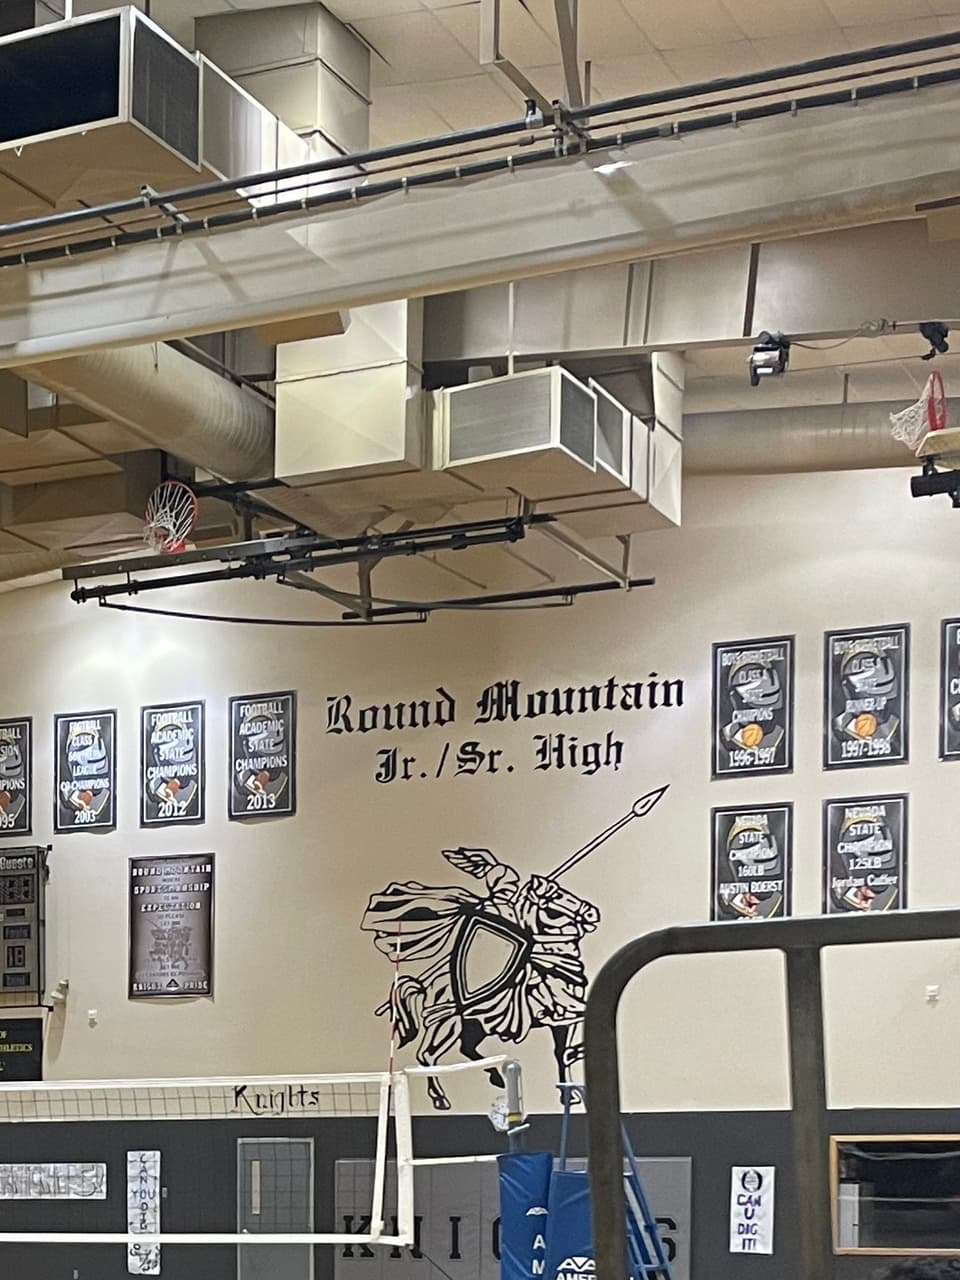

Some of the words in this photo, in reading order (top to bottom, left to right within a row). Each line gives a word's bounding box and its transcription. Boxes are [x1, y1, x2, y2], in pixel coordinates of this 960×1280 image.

[852, 658, 873, 671] CLASS
[740, 669, 761, 680] CLASS
[240, 701, 284, 717] FOOTBALL
[326, 687, 456, 735] Round
[474, 671, 685, 725] Mountain
[151, 710, 193, 726] FOOTBALL
[732, 708, 773, 722] CHAMPIONS
[69, 720, 101, 732] FOOTBALL
[239, 719, 284, 736] ACADEMIC
[151, 728, 194, 744] ACADEMIC
[248, 739, 275, 752] STATE
[159, 748, 185, 760] STATE
[533, 731, 625, 776] High
[235, 755, 288, 771] CHAMPIONS
[147, 763, 197, 779] CHAMPIONS
[247, 793, 276, 810] 2013
[158, 801, 187, 817] 2012
[845, 805, 886, 817] NEVADA
[74, 811, 96, 824] 2003
[849, 823, 882, 836] STATE
[739, 833, 765, 844] STATE
[837, 840, 893, 854] CHAMPION
[0, 857, 34, 870] Guests
[132, 867, 162, 877] ROUND
[164, 864, 212, 875] MOUNTAIN
[133, 883, 210, 895] SPORTSMANSHIP
[141, 902, 201, 912] EXPECTATION
[232, 1084, 320, 1116] Knights
[130, 1189, 156, 1200] YOU
[737, 1193, 761, 1207] CAN
[744, 1207, 755, 1220] U
[737, 1223, 758, 1235] DIG
